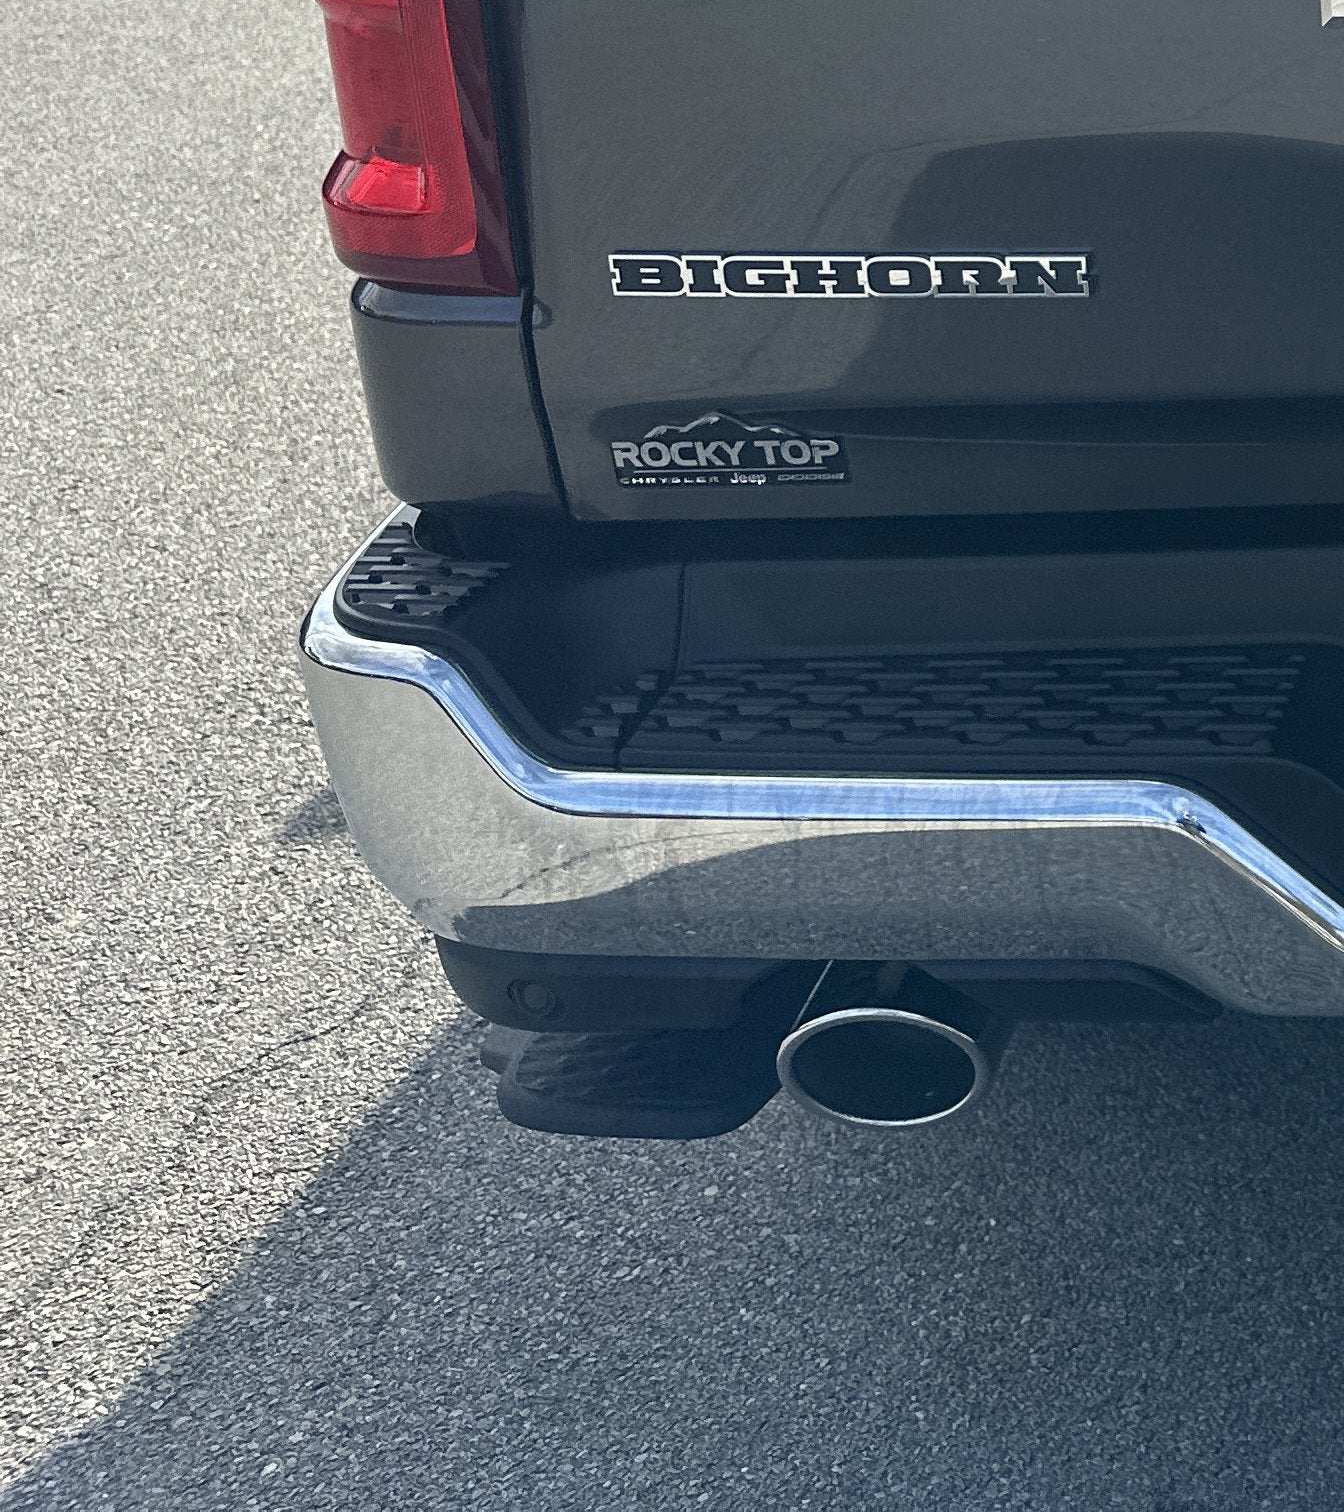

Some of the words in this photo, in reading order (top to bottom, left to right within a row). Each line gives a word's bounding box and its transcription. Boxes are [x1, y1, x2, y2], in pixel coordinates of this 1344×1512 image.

[607, 253, 1092, 298] BIGHORN
[611, 440, 745, 468] ROCKY
[753, 439, 840, 466] TOP
[619, 474, 721, 485] CHRYSLER
[729, 471, 768, 485] Jeep
